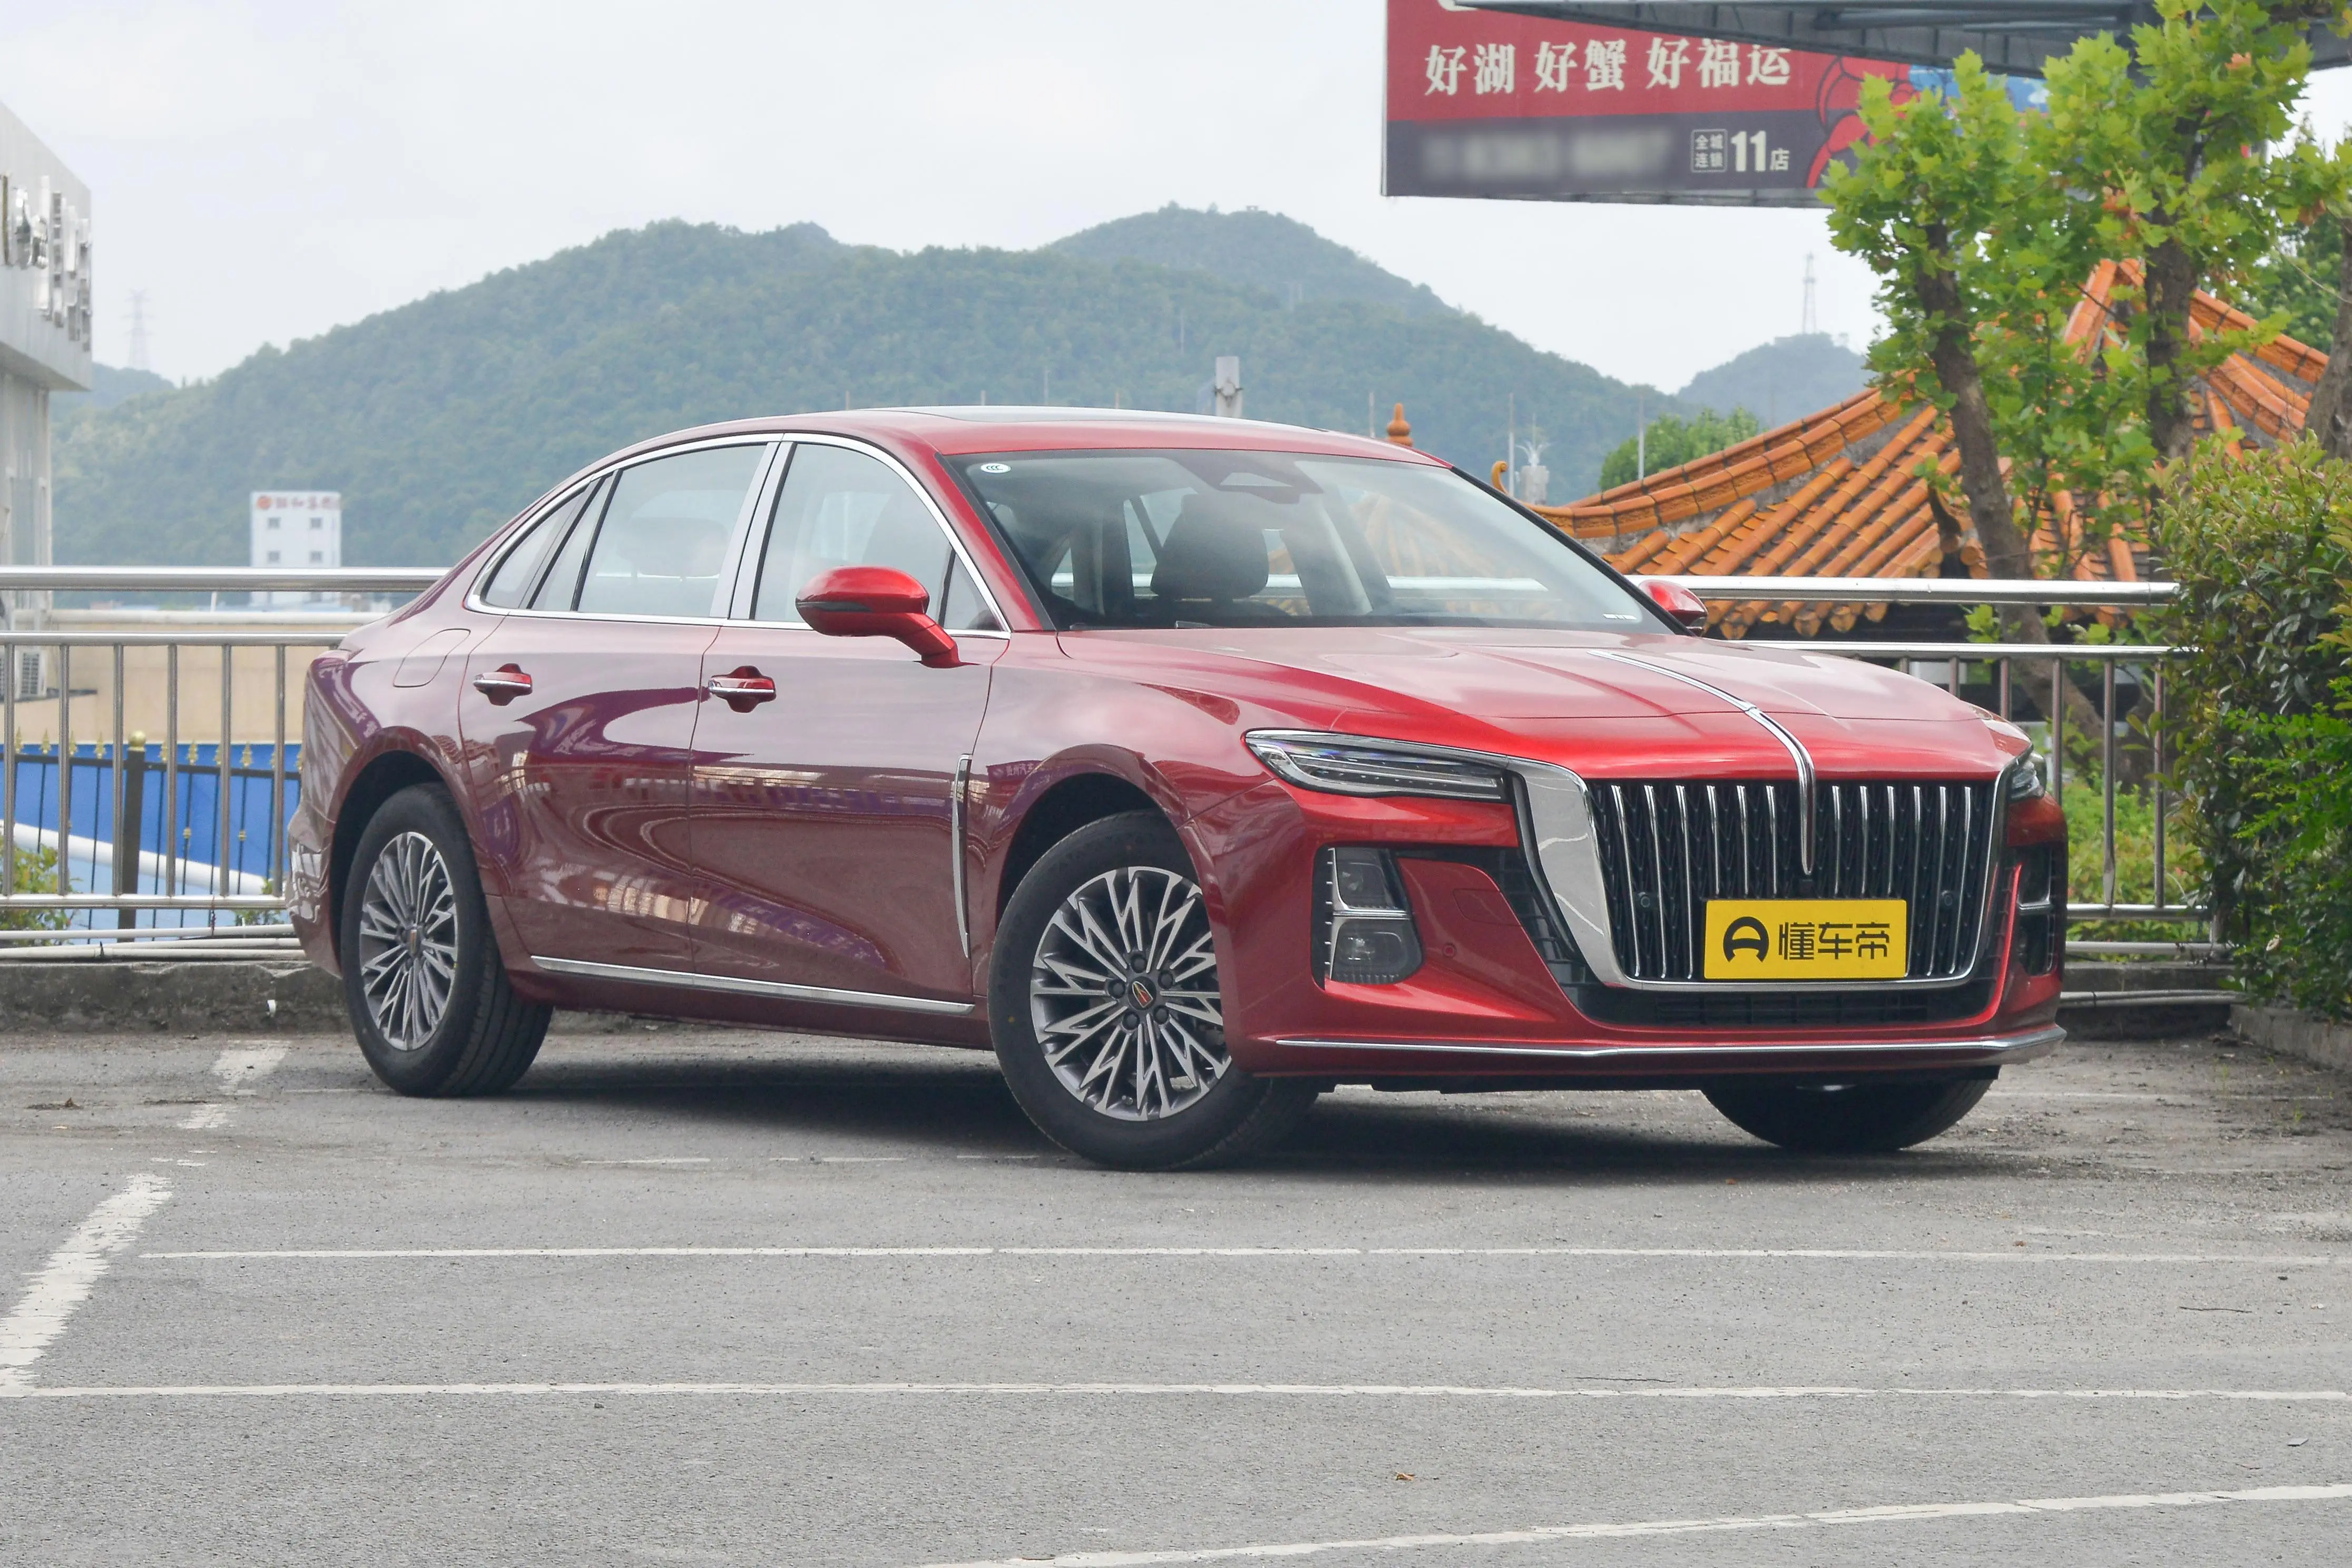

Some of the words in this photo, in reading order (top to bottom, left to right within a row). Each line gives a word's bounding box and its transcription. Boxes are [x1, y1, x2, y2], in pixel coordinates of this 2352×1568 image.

[1425, 43, 1515, 95] 好湖
[1534, 39, 1626, 93] 好蟹
[1646, 37, 1791, 89] 好福运
[1730, 130, 1790, 172] 11店
[1778, 921, 1890, 961] 懂车帝
